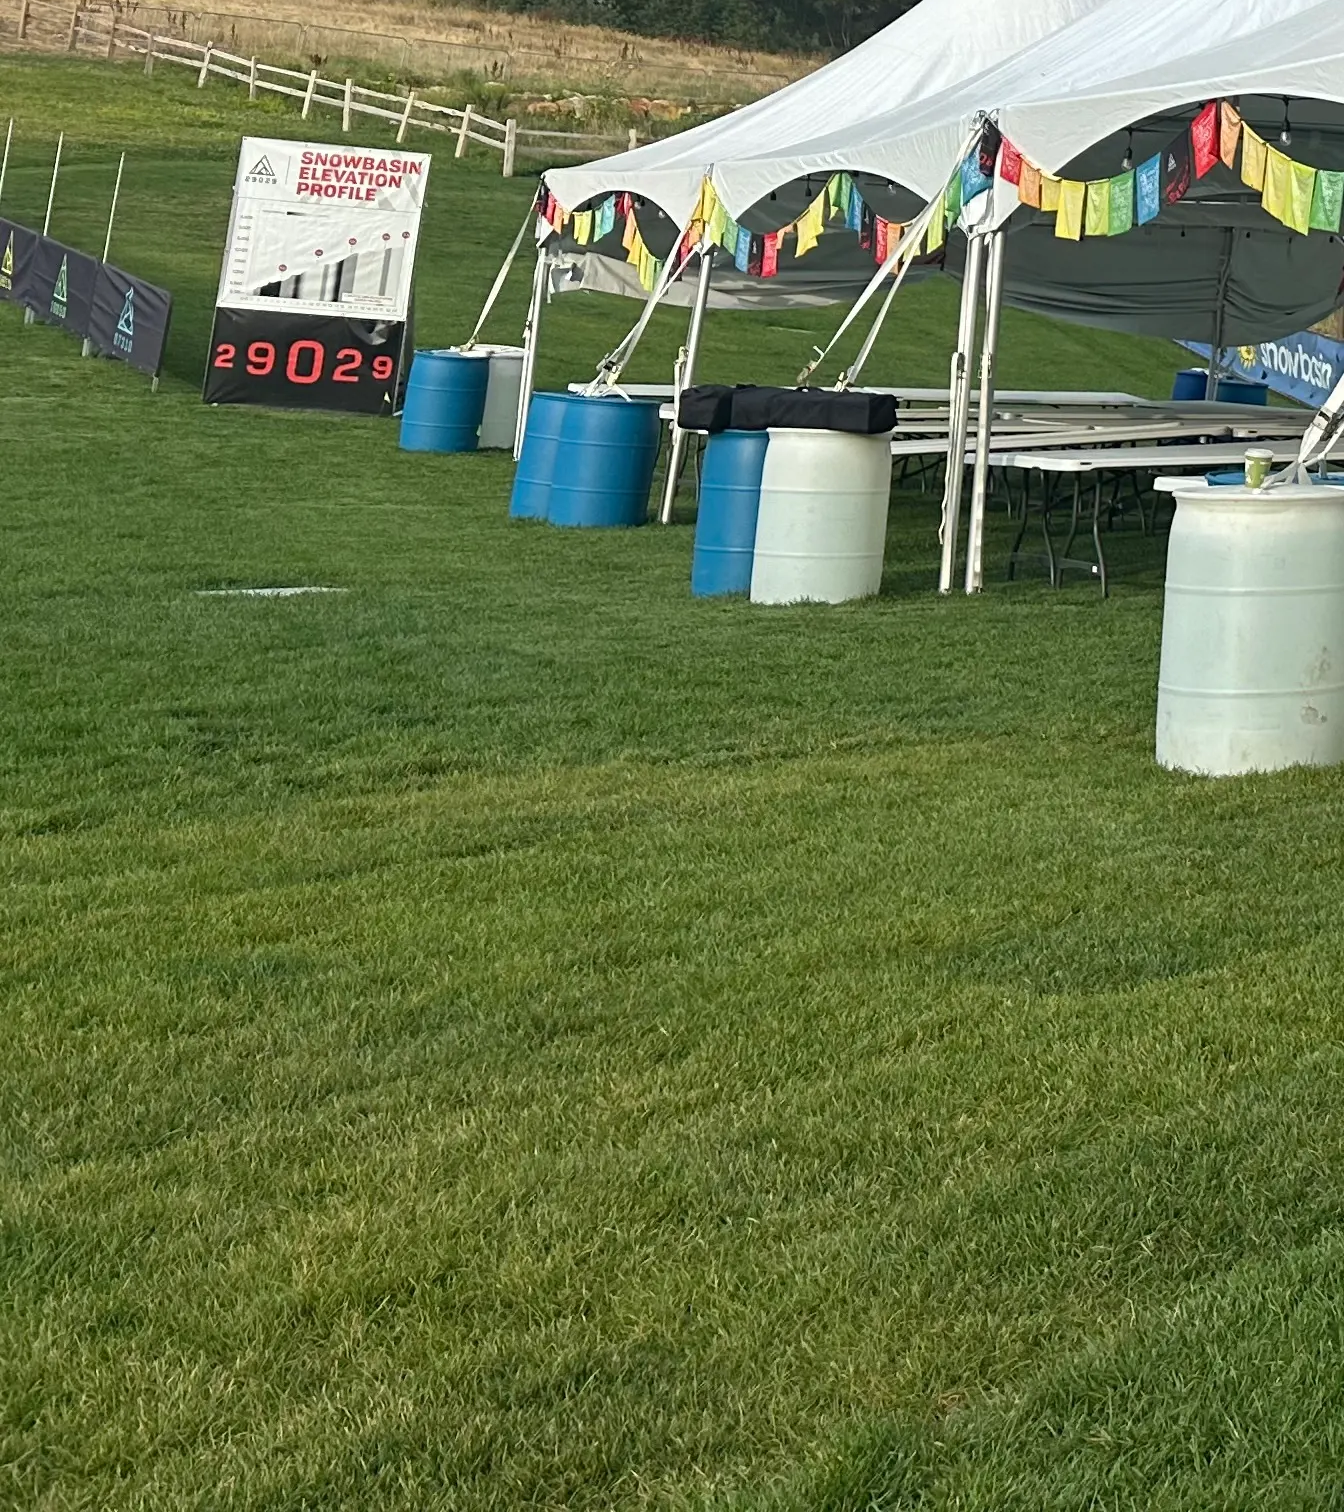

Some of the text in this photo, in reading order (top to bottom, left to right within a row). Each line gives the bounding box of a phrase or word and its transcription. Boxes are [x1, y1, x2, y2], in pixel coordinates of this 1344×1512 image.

[301, 151, 423, 176] SNOWBASIN
[299, 167, 403, 189] ELEVATION
[296, 182, 378, 202] PROFILE
[213, 340, 393, 384] 29029
